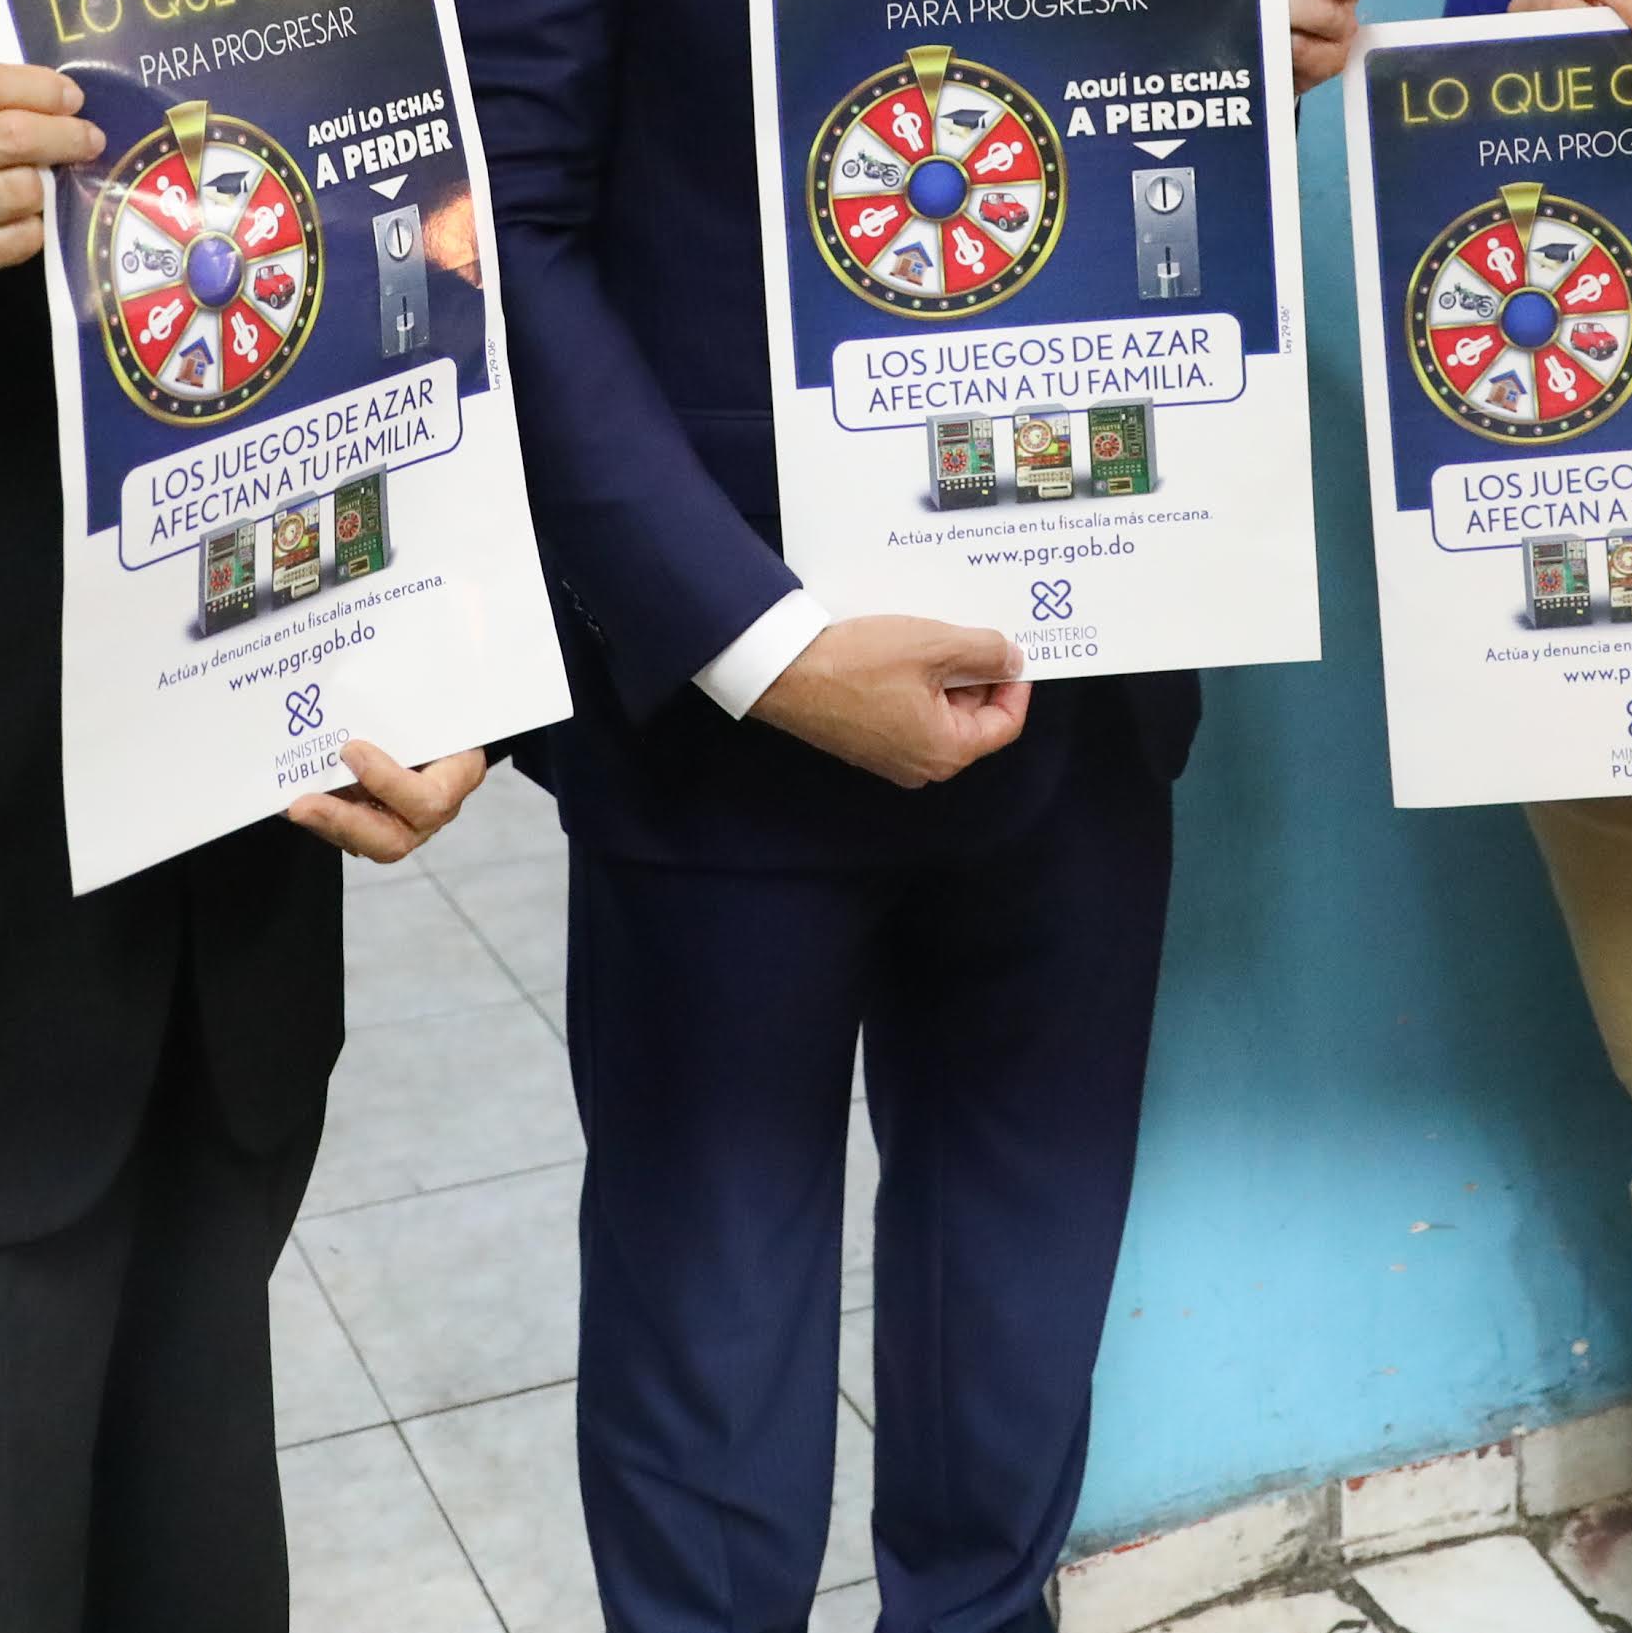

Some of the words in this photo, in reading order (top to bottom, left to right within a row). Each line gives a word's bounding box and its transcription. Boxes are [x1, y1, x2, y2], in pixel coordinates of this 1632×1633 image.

[140, 44, 210, 88] PARA
[212, 6, 357, 70] PROGRESAR
[1062, 71, 1127, 100] AQUÍ
[1133, 74, 1165, 96] LO
[1170, 68, 1251, 93] ECHAS
[1401, 77, 1470, 124] LO
[1490, 66, 1594, 115] QUE
[308, 107, 356, 148] AQUÍ
[359, 109, 383, 133] LO
[385, 88, 445, 125] ECHAS
[1066, 105, 1097, 137] A
[1105, 96, 1252, 135] PERDER
[316, 151, 341, 189] A
[343, 119, 453, 179] PERDER
[1478, 135, 1552, 167] PARA
[866, 348, 928, 380] LOS
[934, 336, 1065, 375] JUEGOS
[1072, 333, 1114, 363] DE
[1121, 327, 1210, 360] AZAR
[868, 376, 1007, 413] AFECTAN
[1015, 374, 1036, 401] A
[1041, 370, 1079, 398] TU
[1087, 362, 1213, 395] FAMILIA.
[151, 459, 205, 507] LOS
[210, 417, 319, 486] JUEGOS
[325, 402, 358, 442] DE
[363, 377, 433, 428] AZAR
[149, 472, 270, 545] AFECTAN
[276, 466, 293, 497] A
[298, 449, 330, 486] TU
[336, 416, 435, 474] FAMILIA.
[1463, 472, 1523, 502] LOS
[1465, 499, 1600, 534] AFECTAN
[1607, 497, 1628, 523] A
[967, 533, 1135, 567] www.pgr.gob.do
[228, 619, 372, 691] www.pgr.gob.do
[1014, 624, 1098, 646] MINISTERIO
[1027, 641, 1098, 661] ÚBLICO
[1485, 647, 1529, 663] Actúa
[1542, 640, 1611, 658] denuncia
[1613, 641, 1632, 653] en
